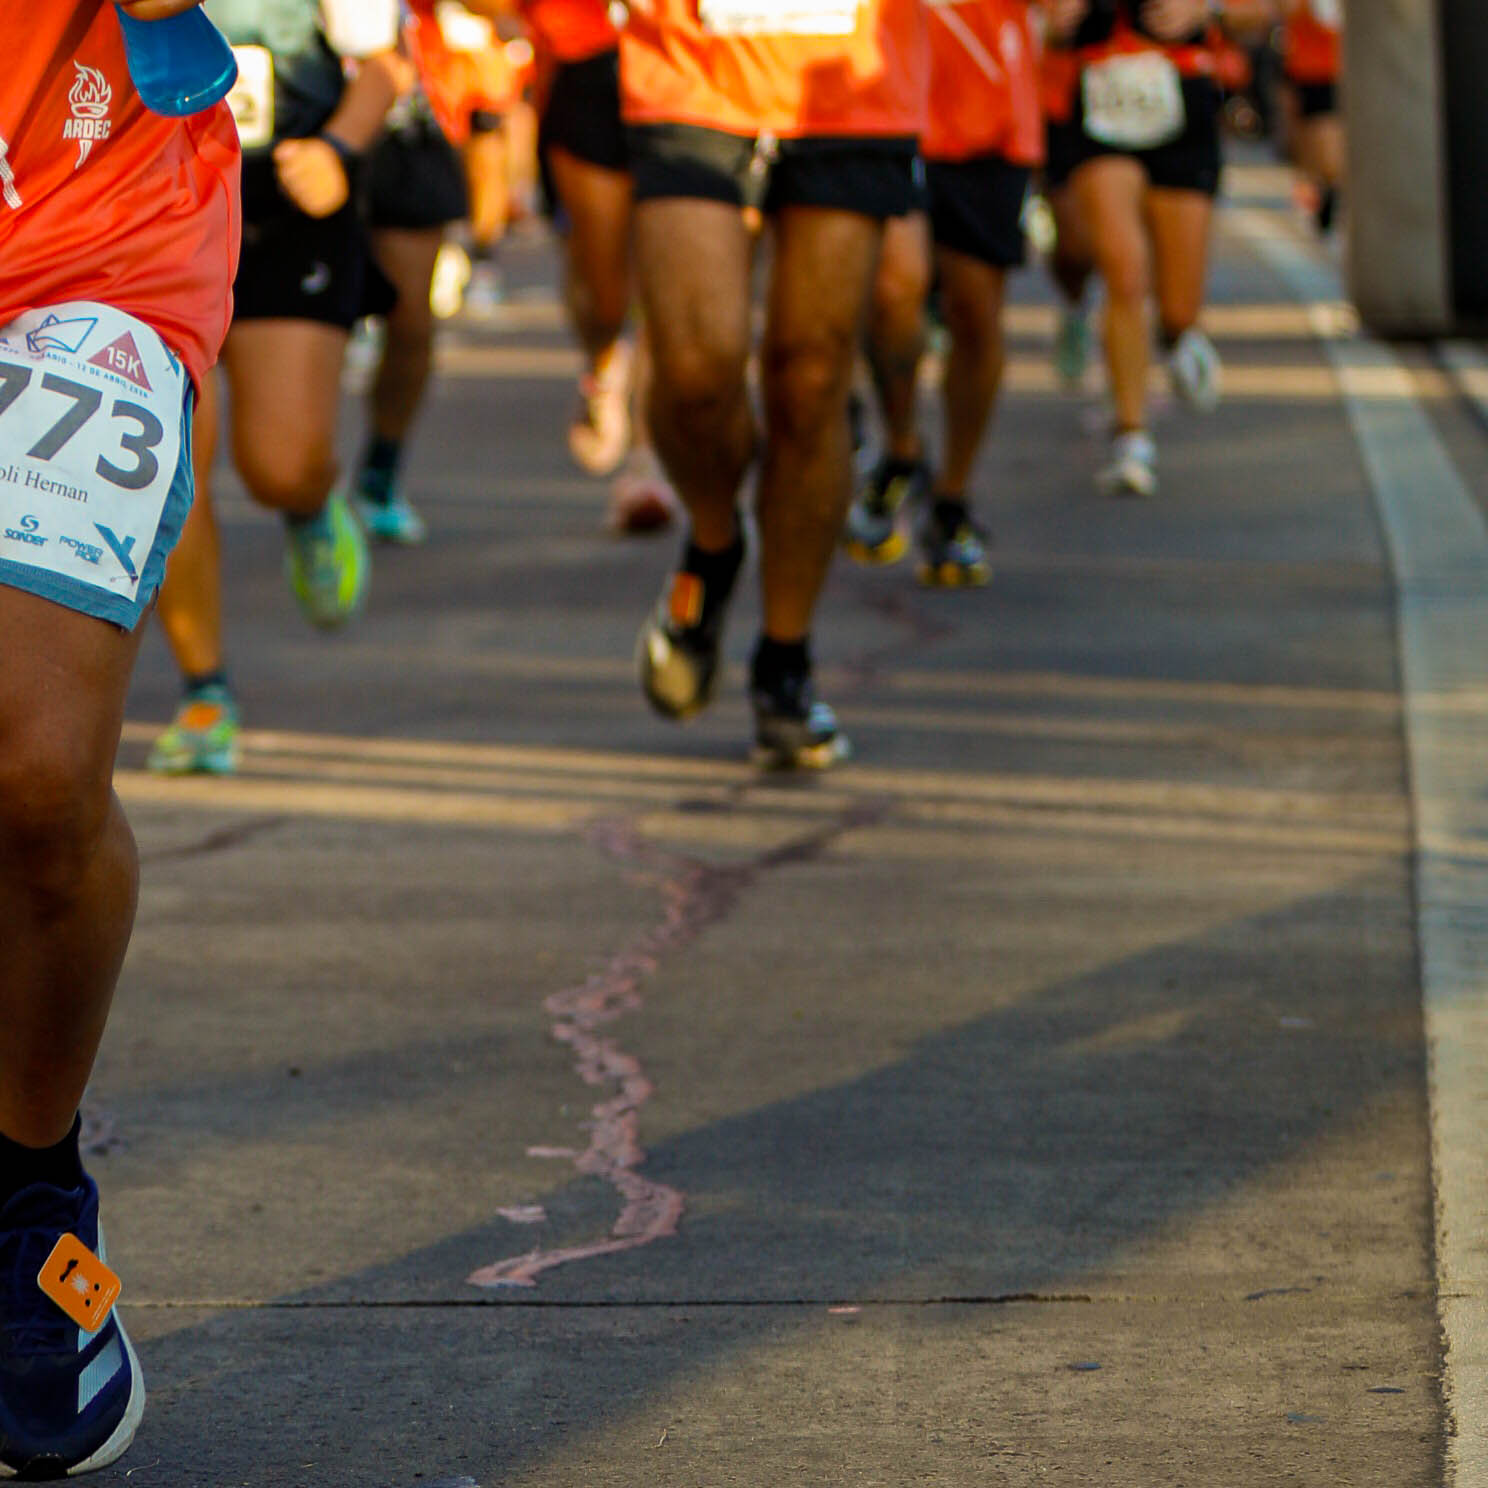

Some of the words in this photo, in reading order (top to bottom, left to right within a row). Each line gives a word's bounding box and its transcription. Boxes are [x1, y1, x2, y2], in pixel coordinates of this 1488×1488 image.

[62, 117, 112, 140] ARDEC
[107, 346, 141, 379] 15K
[24, 469, 89, 503] Hernan
[59, 535, 104, 557] POWER
